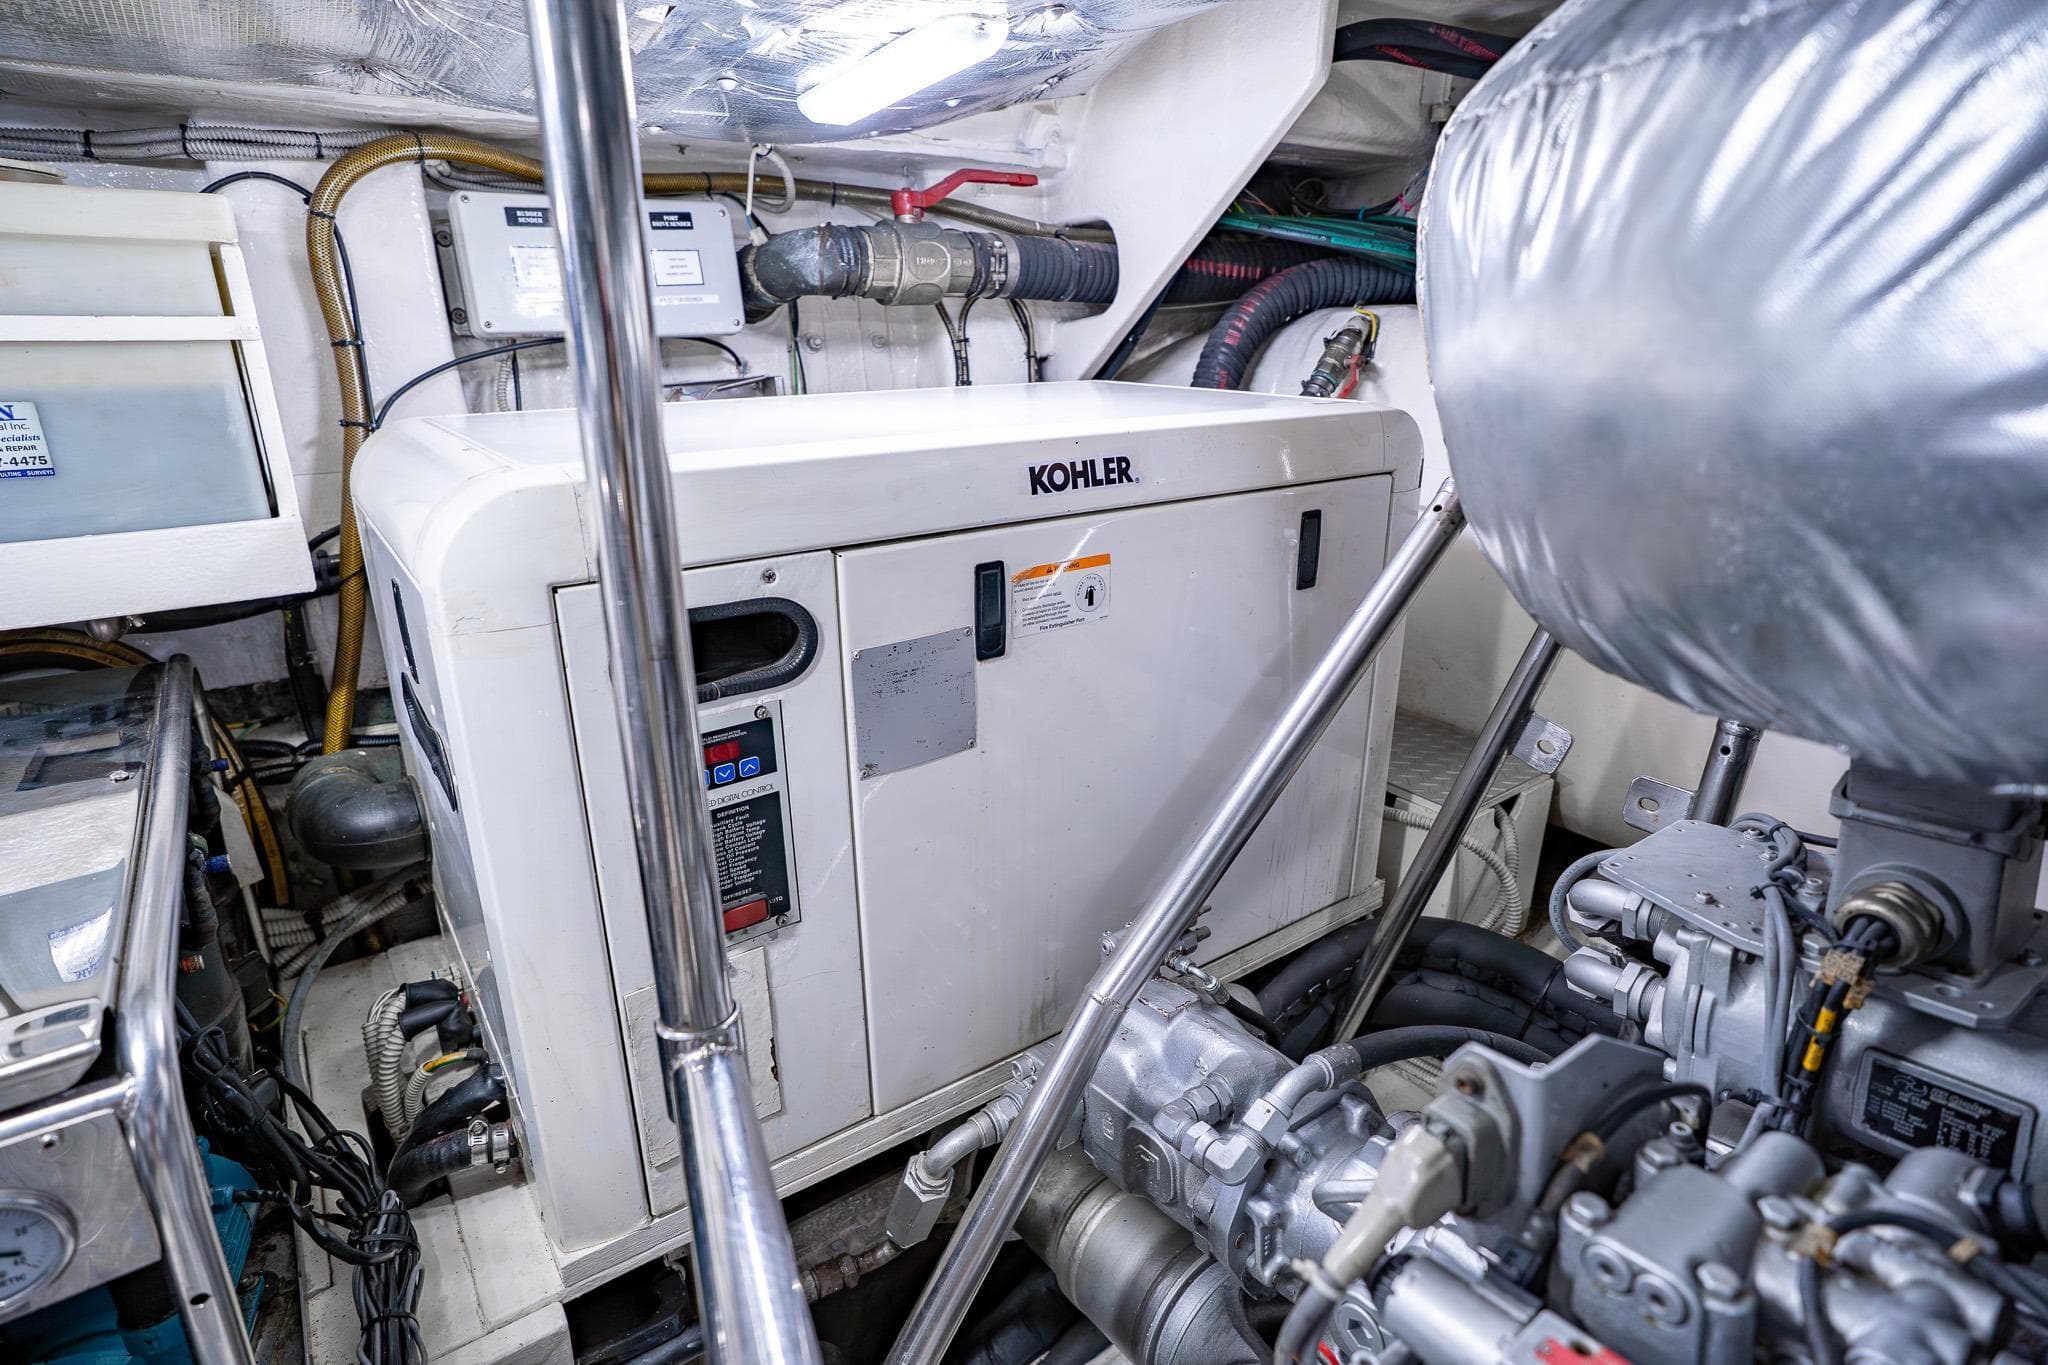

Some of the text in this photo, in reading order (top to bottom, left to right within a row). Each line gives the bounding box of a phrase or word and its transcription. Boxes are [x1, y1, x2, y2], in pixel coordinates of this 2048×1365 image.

[0, 456, 48, 467] -4475
[1028, 456, 1134, 495] KOHLER
[1049, 619, 1076, 629] Extinguisher
[718, 793, 740, 804] DIGITAL
[741, 784, 774, 799] CONTROL
[717, 805, 750, 819] DEFINITION
[735, 813, 750, 821] Fault
